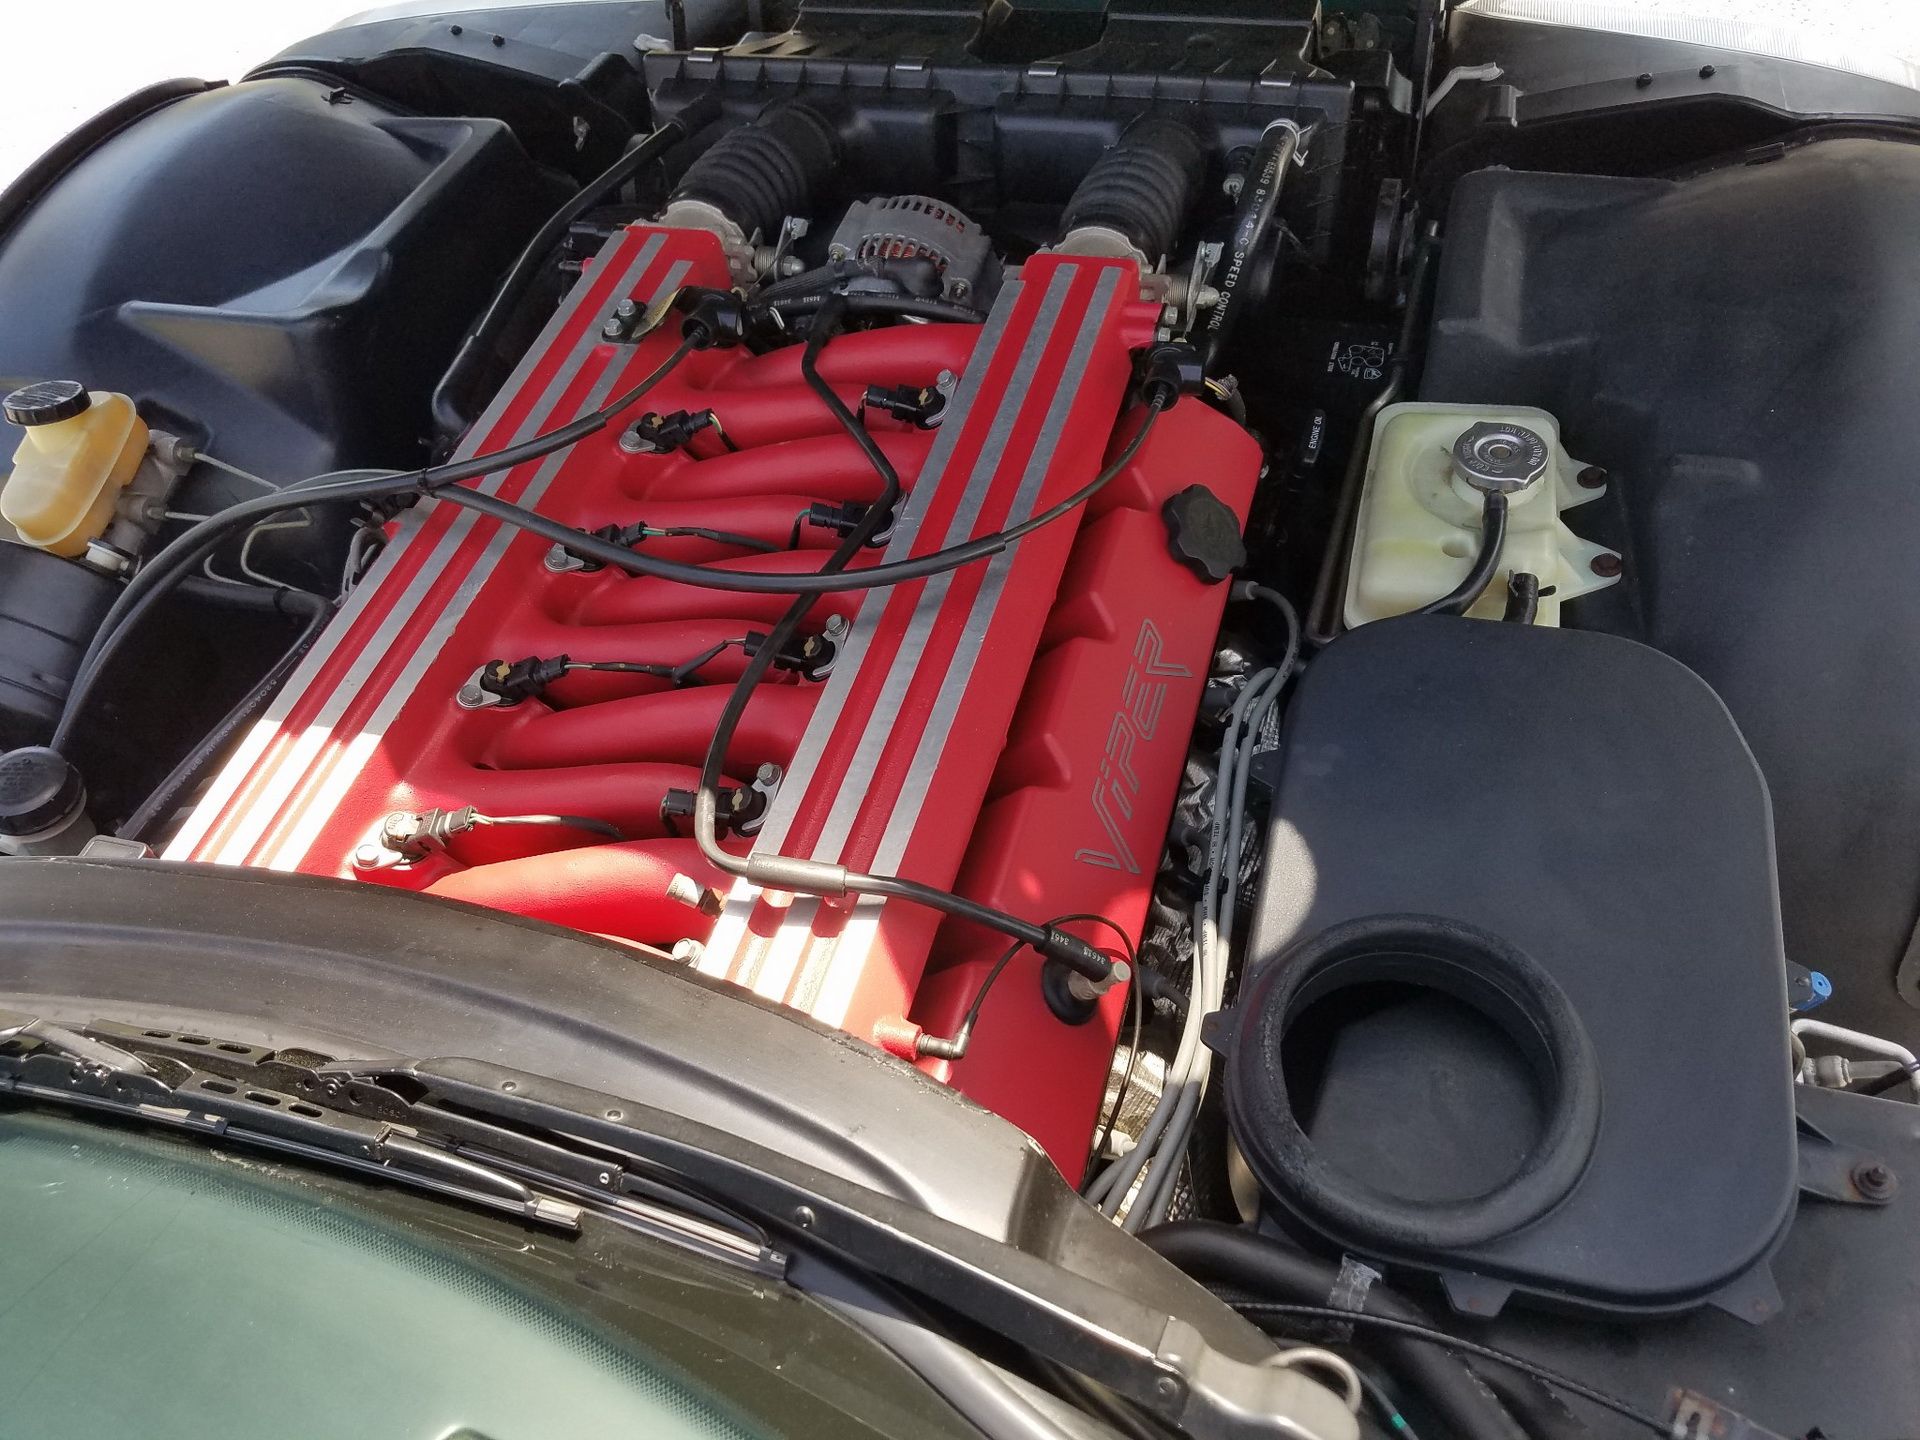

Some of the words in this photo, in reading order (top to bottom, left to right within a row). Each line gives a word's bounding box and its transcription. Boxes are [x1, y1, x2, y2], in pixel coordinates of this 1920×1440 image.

[1224, 252, 1245, 288] SPEED
[1207, 291, 1231, 330] CONTROL
[1308, 426, 1321, 449] ENGINE
[1075, 618, 1193, 874] VIPER
